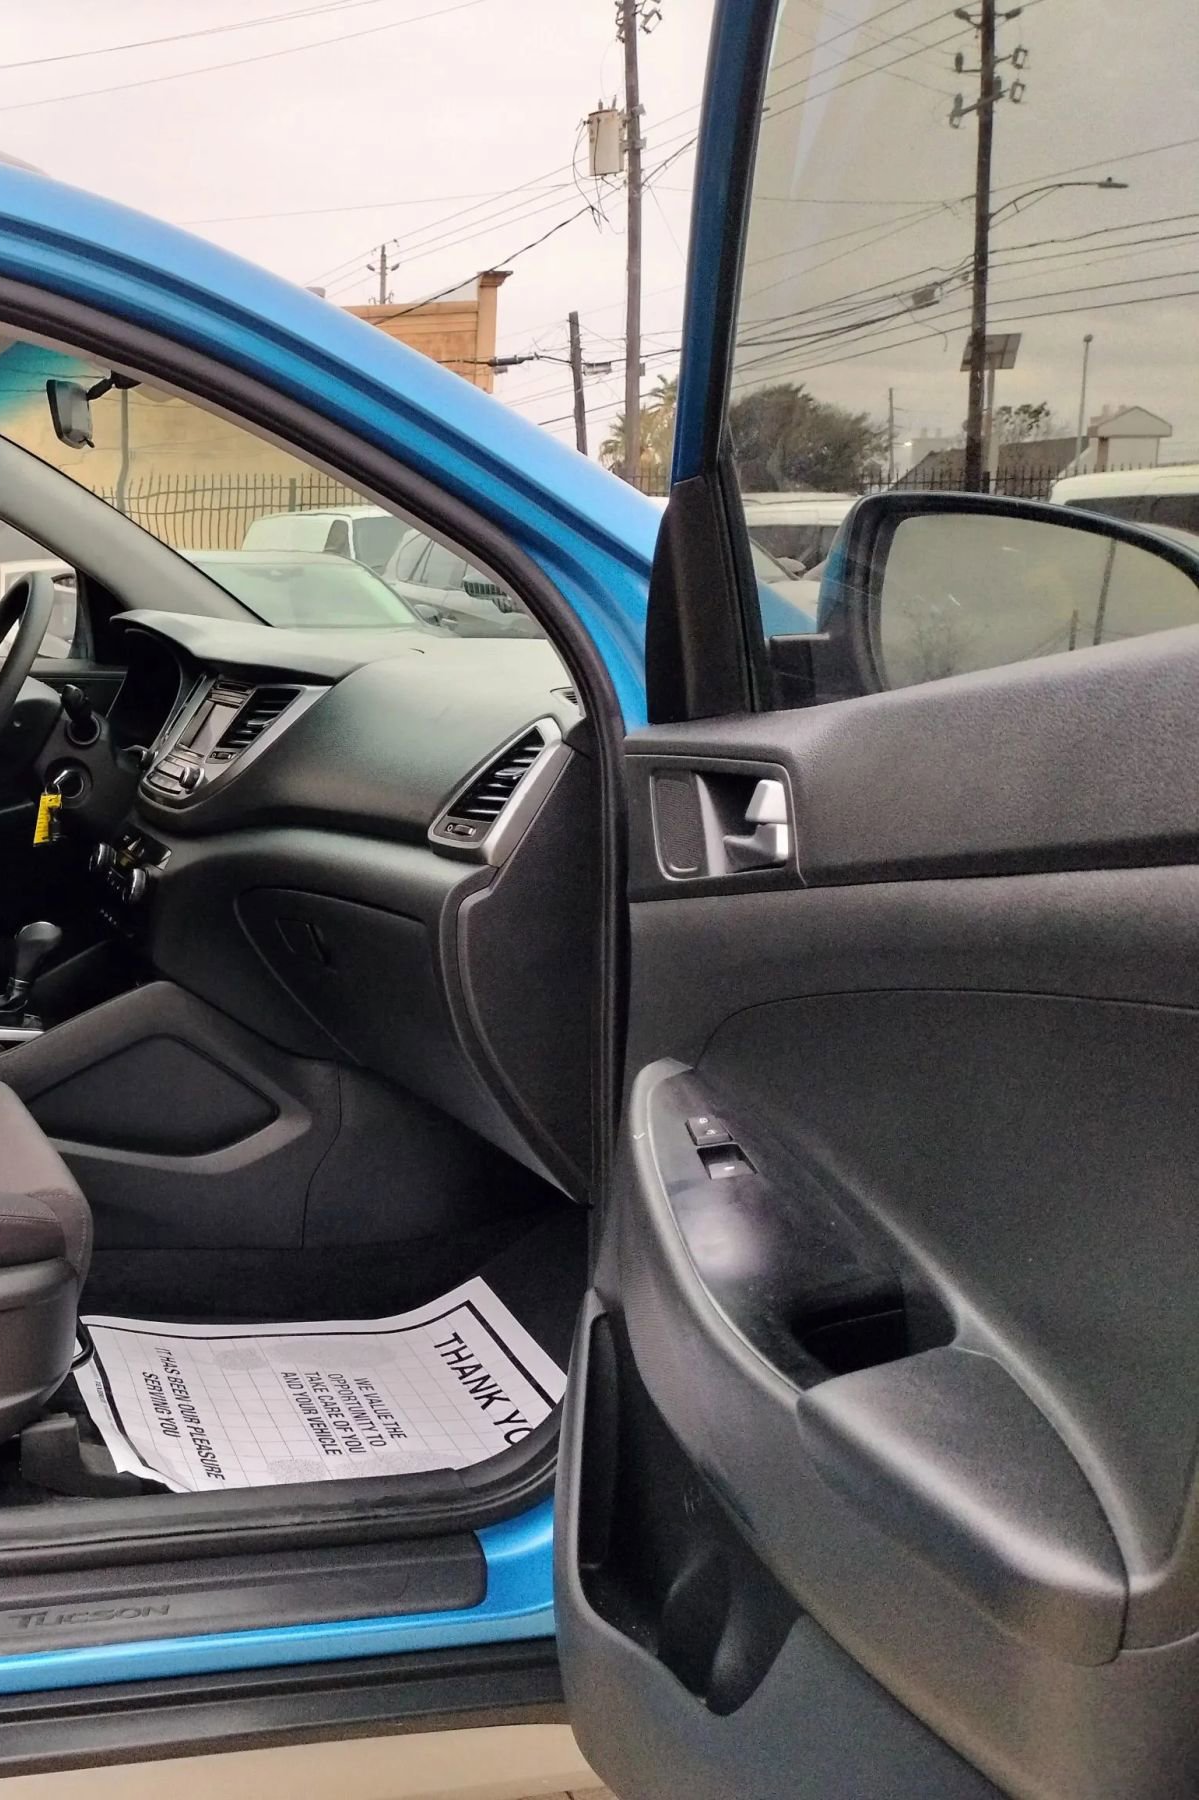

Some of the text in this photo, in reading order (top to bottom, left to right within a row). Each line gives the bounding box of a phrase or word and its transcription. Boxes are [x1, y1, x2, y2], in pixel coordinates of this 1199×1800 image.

[142, 1371, 182, 1438] SERVING YOU
[154, 1346, 226, 1481] IT HAS BEEN OUR PLEASURE
[280, 1371, 343, 1456] AND YOUR VEHICLE
[303, 1371, 367, 1454] TAKE CARE OF YOU
[327, 1373, 387, 1447] OPPORTUNITY TO
[353, 1377, 408, 1439] WE VALUE THE
[433, 1331, 534, 1446] THANK YO
[8, 1604, 170, 1629] TUCSON
